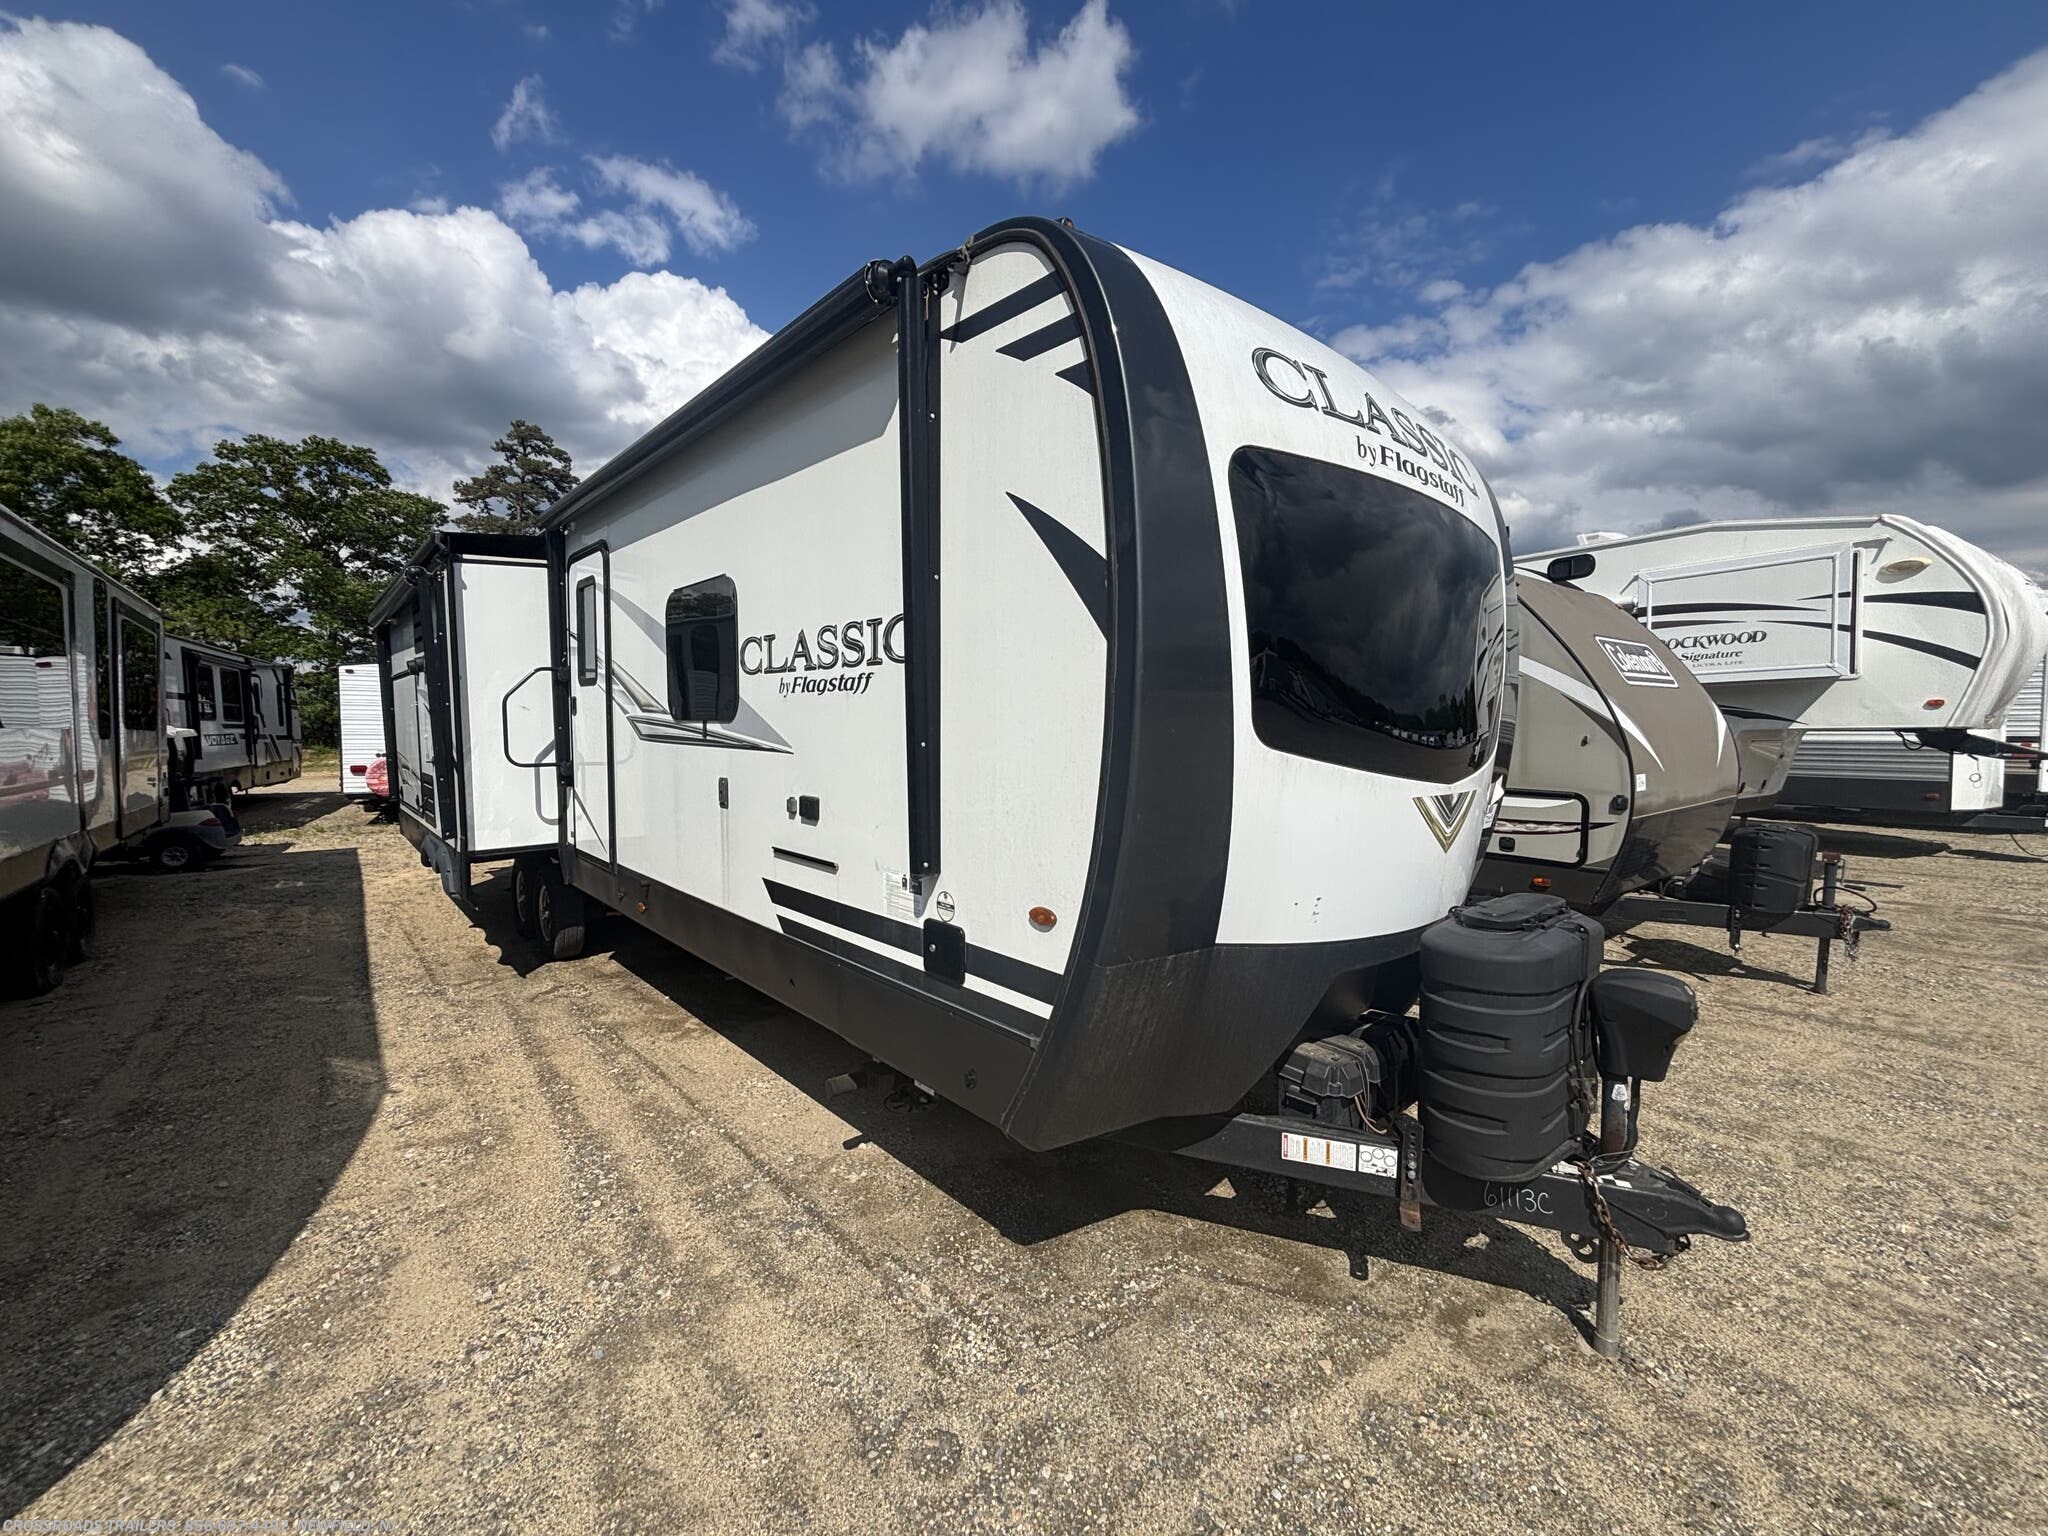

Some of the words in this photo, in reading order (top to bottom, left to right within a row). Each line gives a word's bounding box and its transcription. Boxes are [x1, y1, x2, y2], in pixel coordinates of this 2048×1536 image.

[1251, 347, 1479, 499] CLASSIC
[1356, 435, 1376, 468] by
[1380, 444, 1465, 507] Flagstaff
[1681, 650, 1743, 662] Signature
[778, 677, 792, 698] by
[791, 672, 874, 696] Flagstaff
[1484, 1181, 1554, 1214] 61113C
